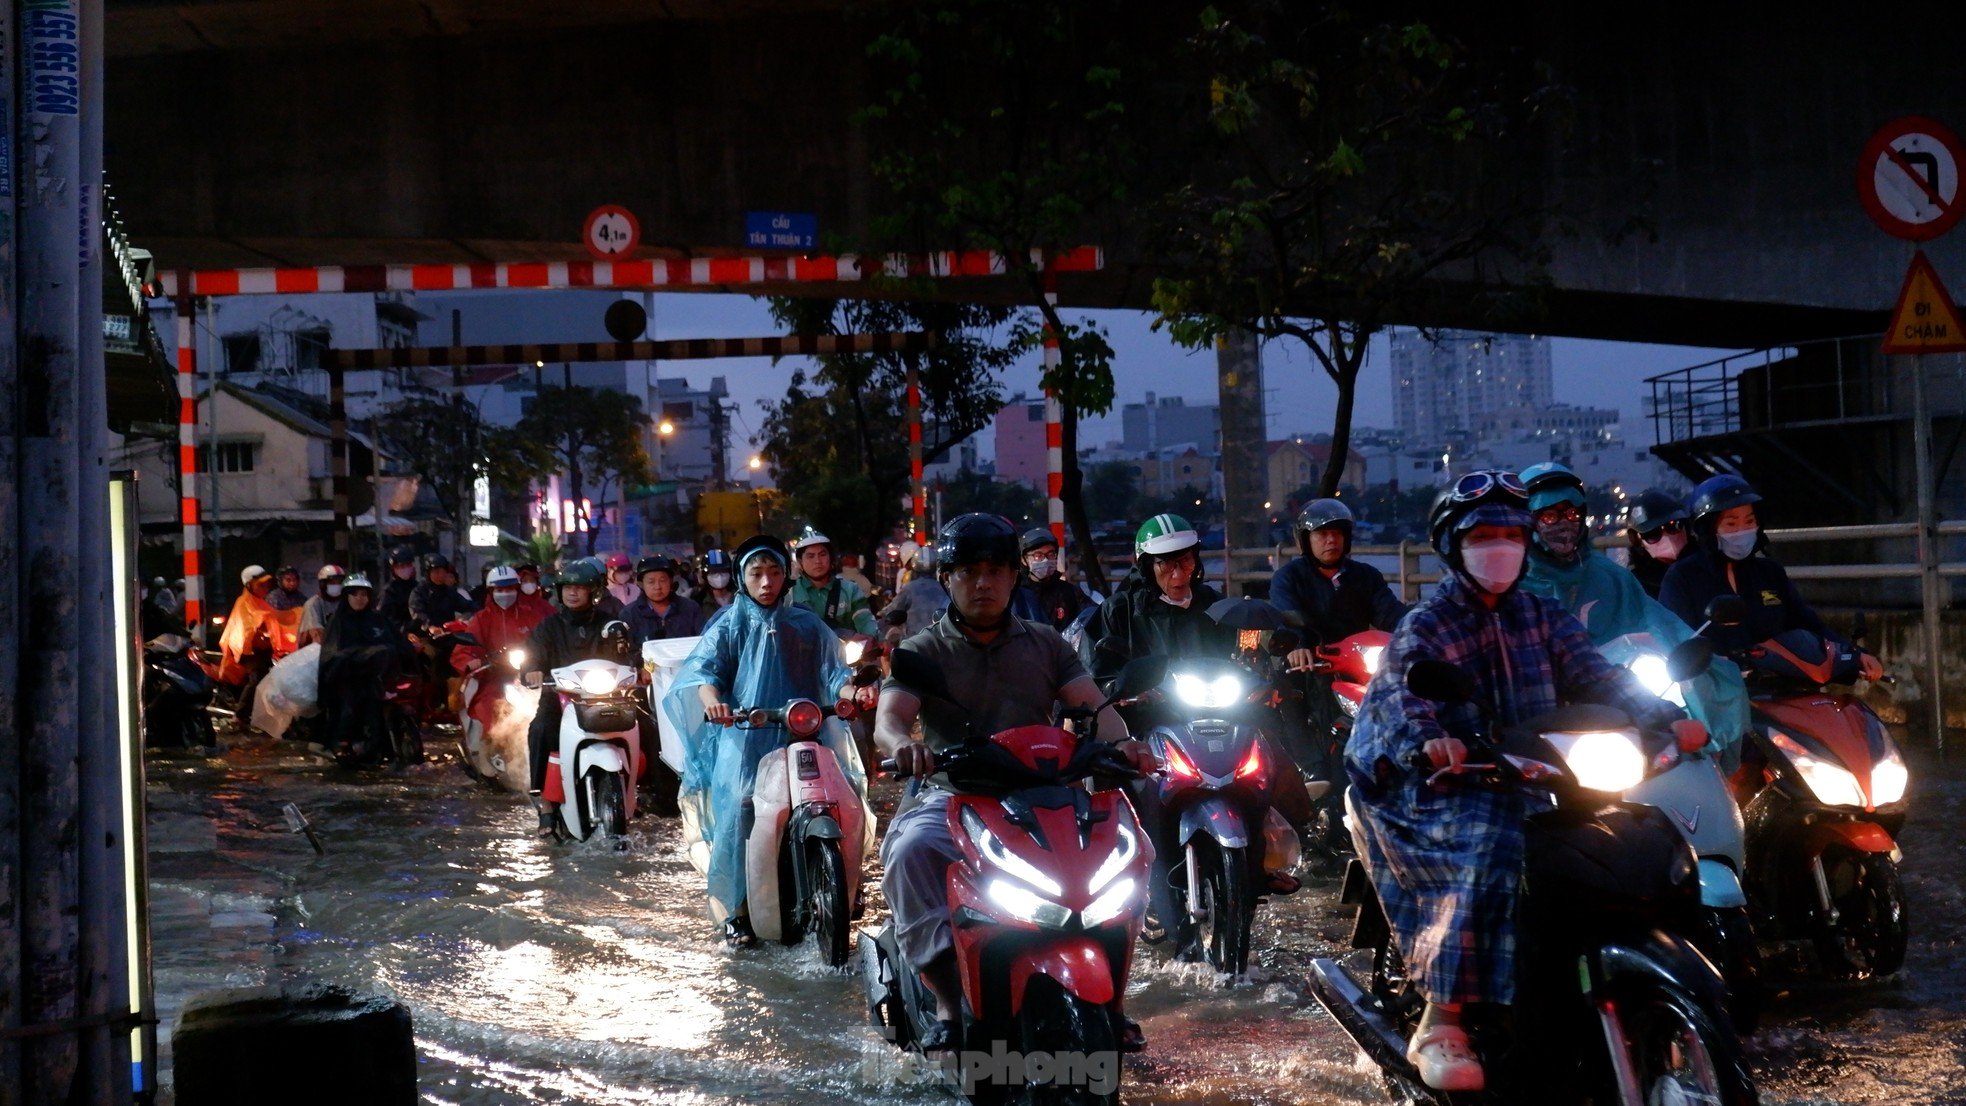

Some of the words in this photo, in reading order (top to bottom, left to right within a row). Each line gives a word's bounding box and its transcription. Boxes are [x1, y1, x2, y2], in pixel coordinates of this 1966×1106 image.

[32, 10, 76, 39] 557
[33, 42, 77, 72] 556
[35, 75, 78, 114] 0923
[749, 230, 767, 245] TÂN
[805, 234, 812, 247] 2
[1915, 302, 1931, 316] ĐI
